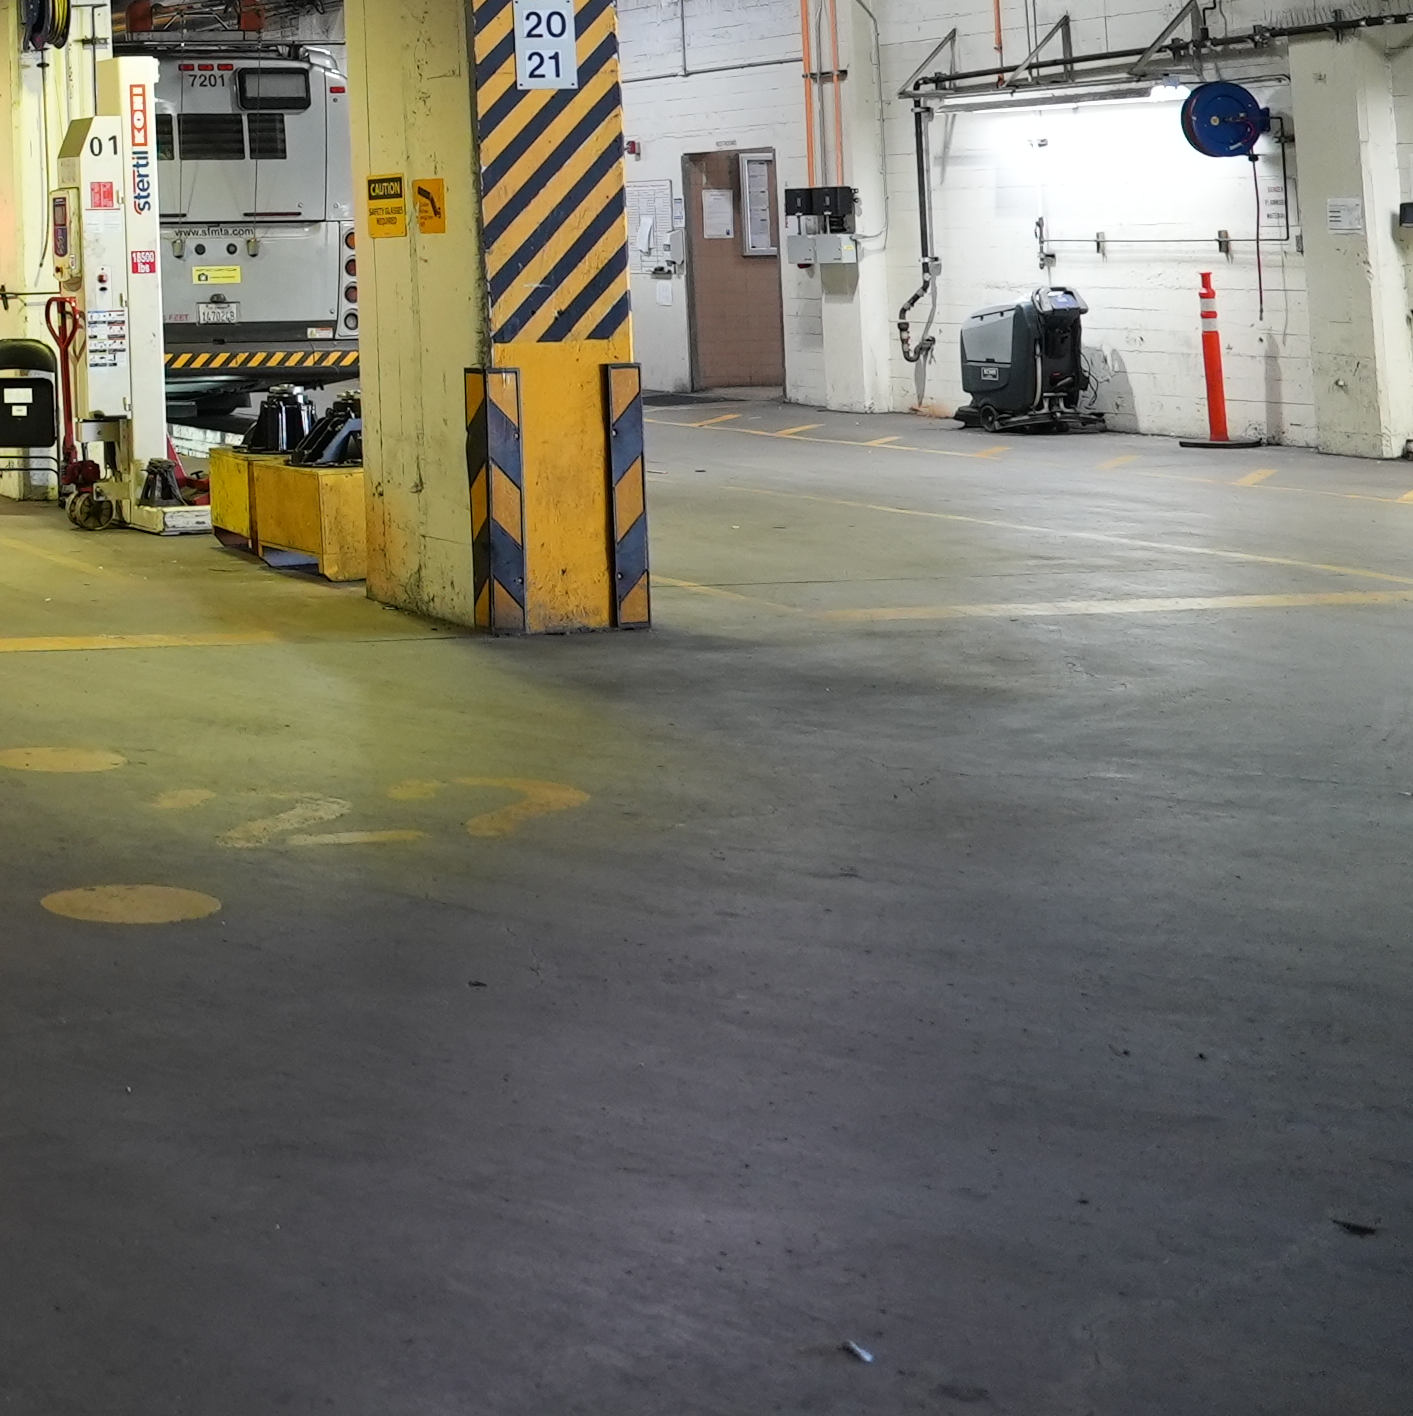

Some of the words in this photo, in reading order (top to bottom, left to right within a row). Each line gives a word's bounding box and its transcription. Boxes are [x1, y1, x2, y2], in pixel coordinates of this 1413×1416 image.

[525, 11, 567, 38] 20
[527, 51, 561, 79] 21
[188, 74, 225, 87] 7201
[131, 86, 146, 144] KONI
[132, 150, 151, 214] stertil
[369, 181, 401, 197] CAUTION
[174, 227, 255, 237] www.sfmta.com
